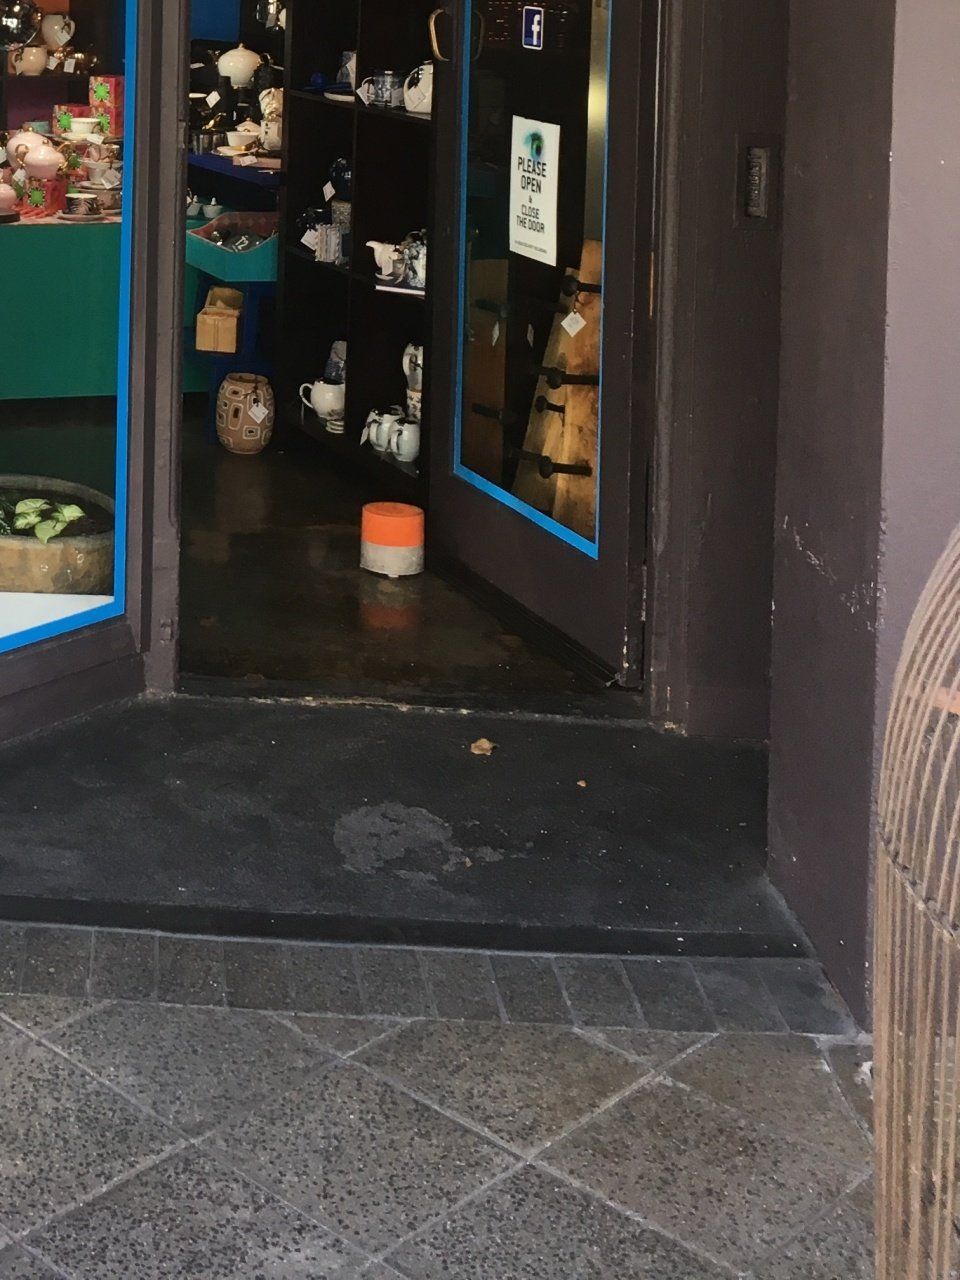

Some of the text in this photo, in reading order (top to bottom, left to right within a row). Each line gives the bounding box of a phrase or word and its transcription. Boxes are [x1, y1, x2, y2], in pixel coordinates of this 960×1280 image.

[517, 156, 547, 178] PLEASE
[520, 174, 542, 194] OPEN
[521, 203, 540, 220] CLOSE
[516, 215, 545, 234] THE DOOR
